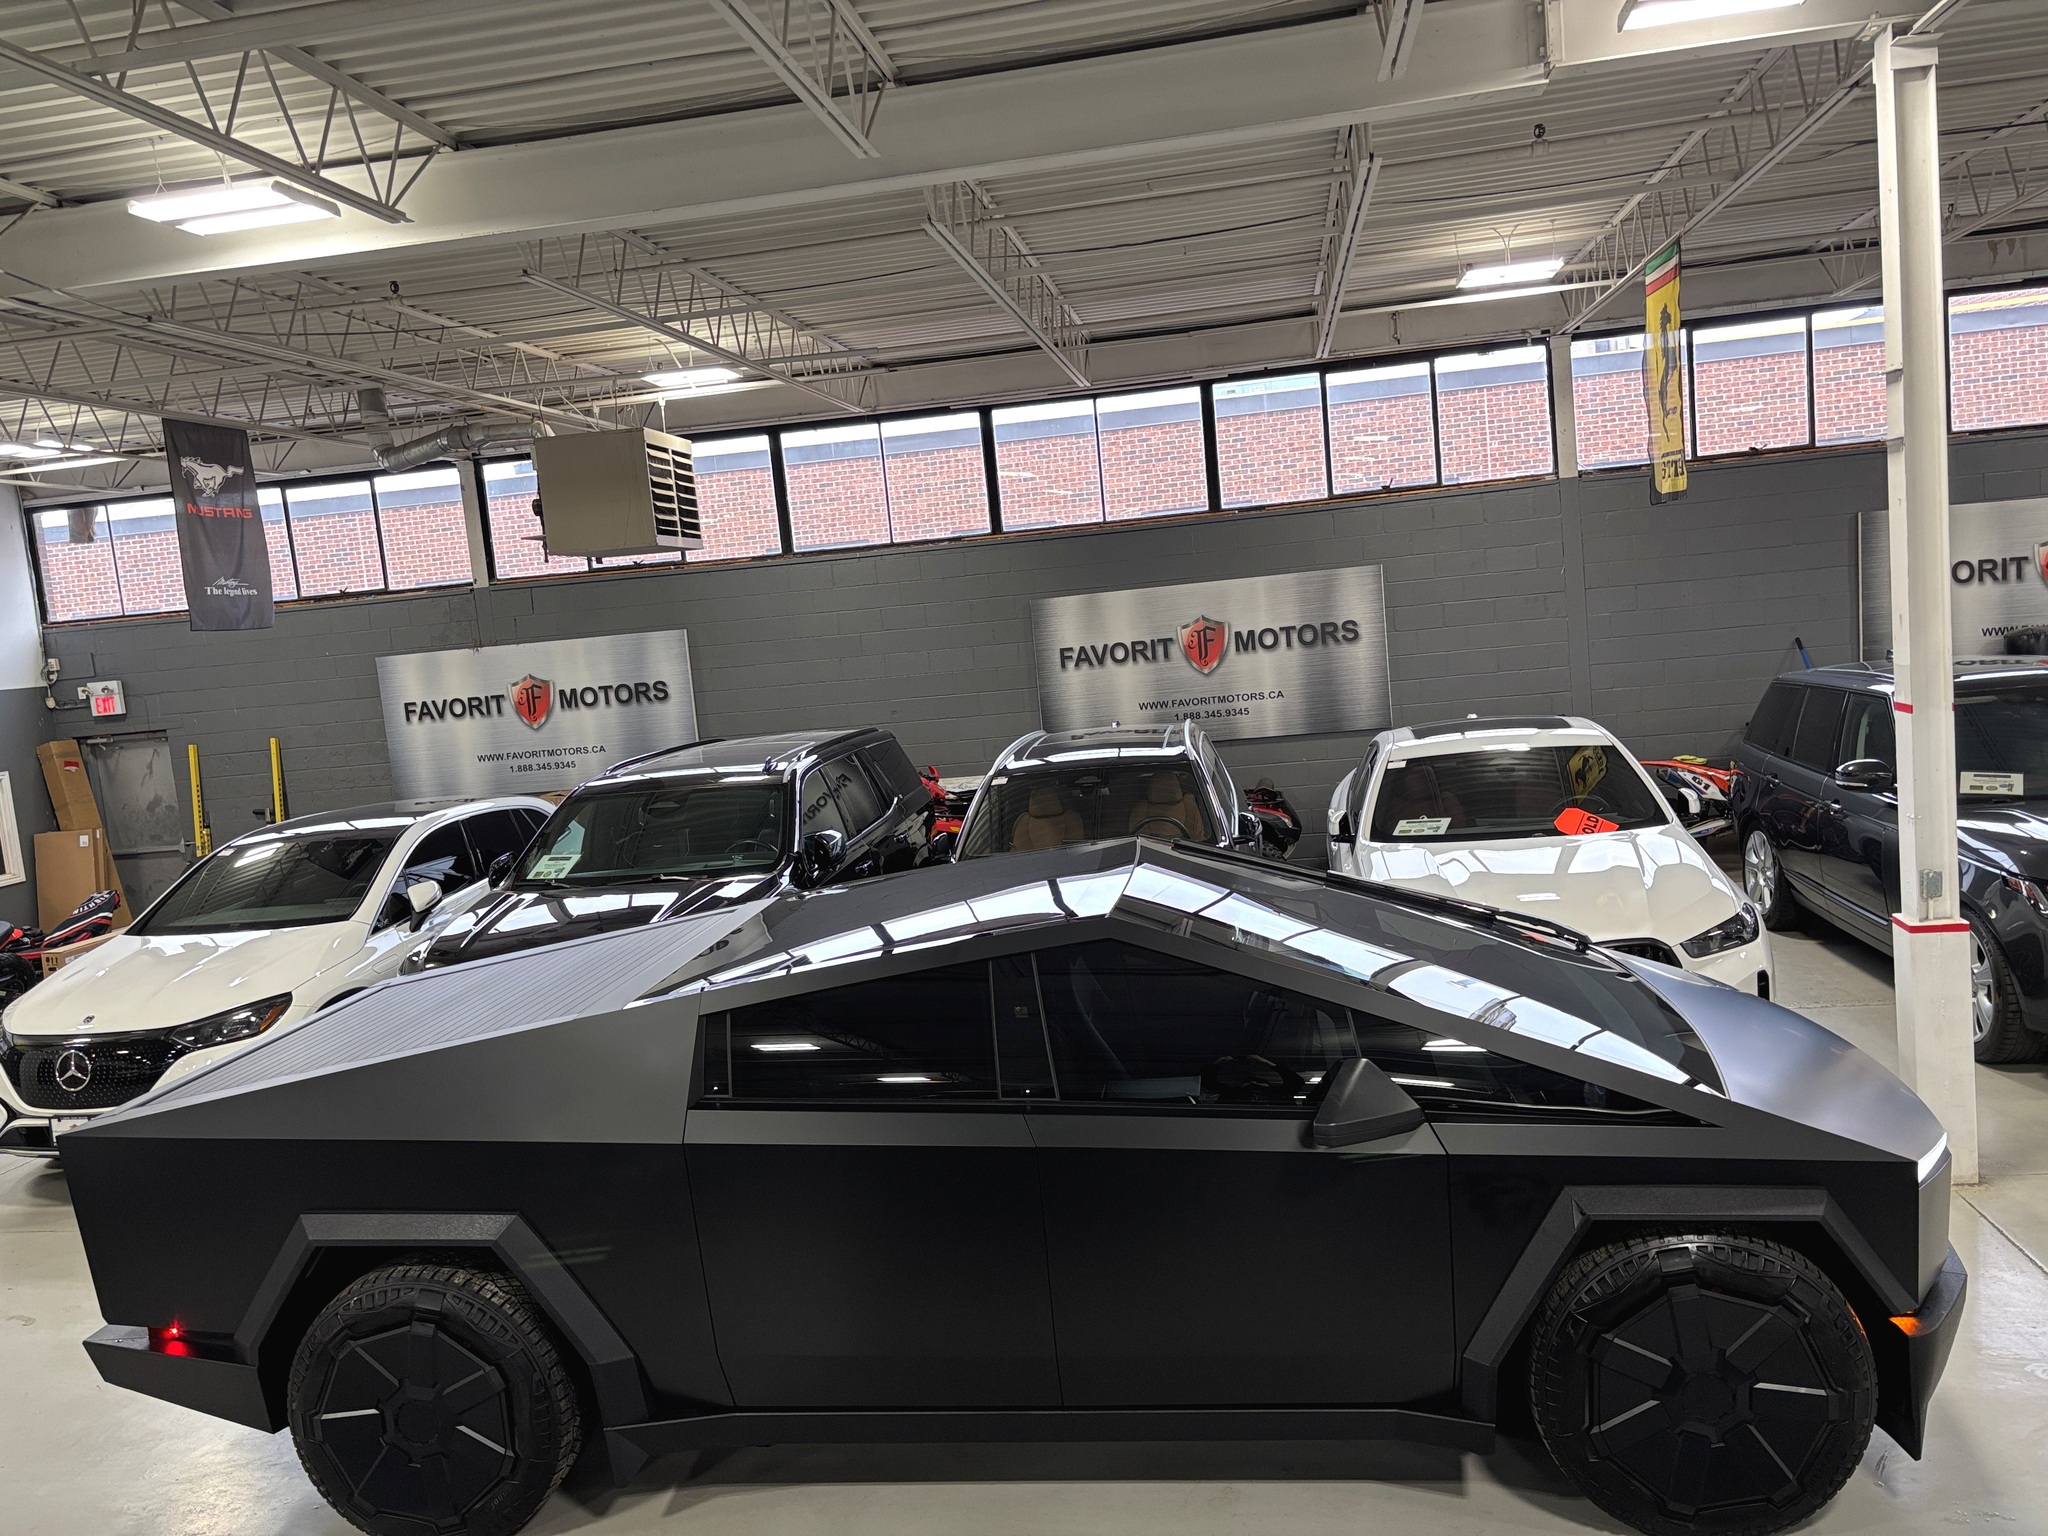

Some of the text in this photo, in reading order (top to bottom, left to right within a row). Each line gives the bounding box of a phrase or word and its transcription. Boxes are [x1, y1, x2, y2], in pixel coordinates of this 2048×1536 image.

[1951, 556, 2029, 584] ORIT
[204, 586, 222, 595] The
[241, 587, 258, 596] lives
[1059, 637, 1173, 670] FAVORIT
[1234, 619, 1360, 653] MOTORS
[94, 696, 116, 715] EXIT
[403, 694, 505, 723] FAVORIT
[558, 680, 669, 709] MOTORS
[1138, 690, 1285, 711] WWW.FAVORITMOTORS.CA
[1174, 707, 1250, 722] 1.888.345.9345
[477, 745, 607, 763] WWW.FAVORITMOTORS.CA
[509, 760, 577, 773] 1.888.345.9345
[1581, 815, 1600, 835] OLD
